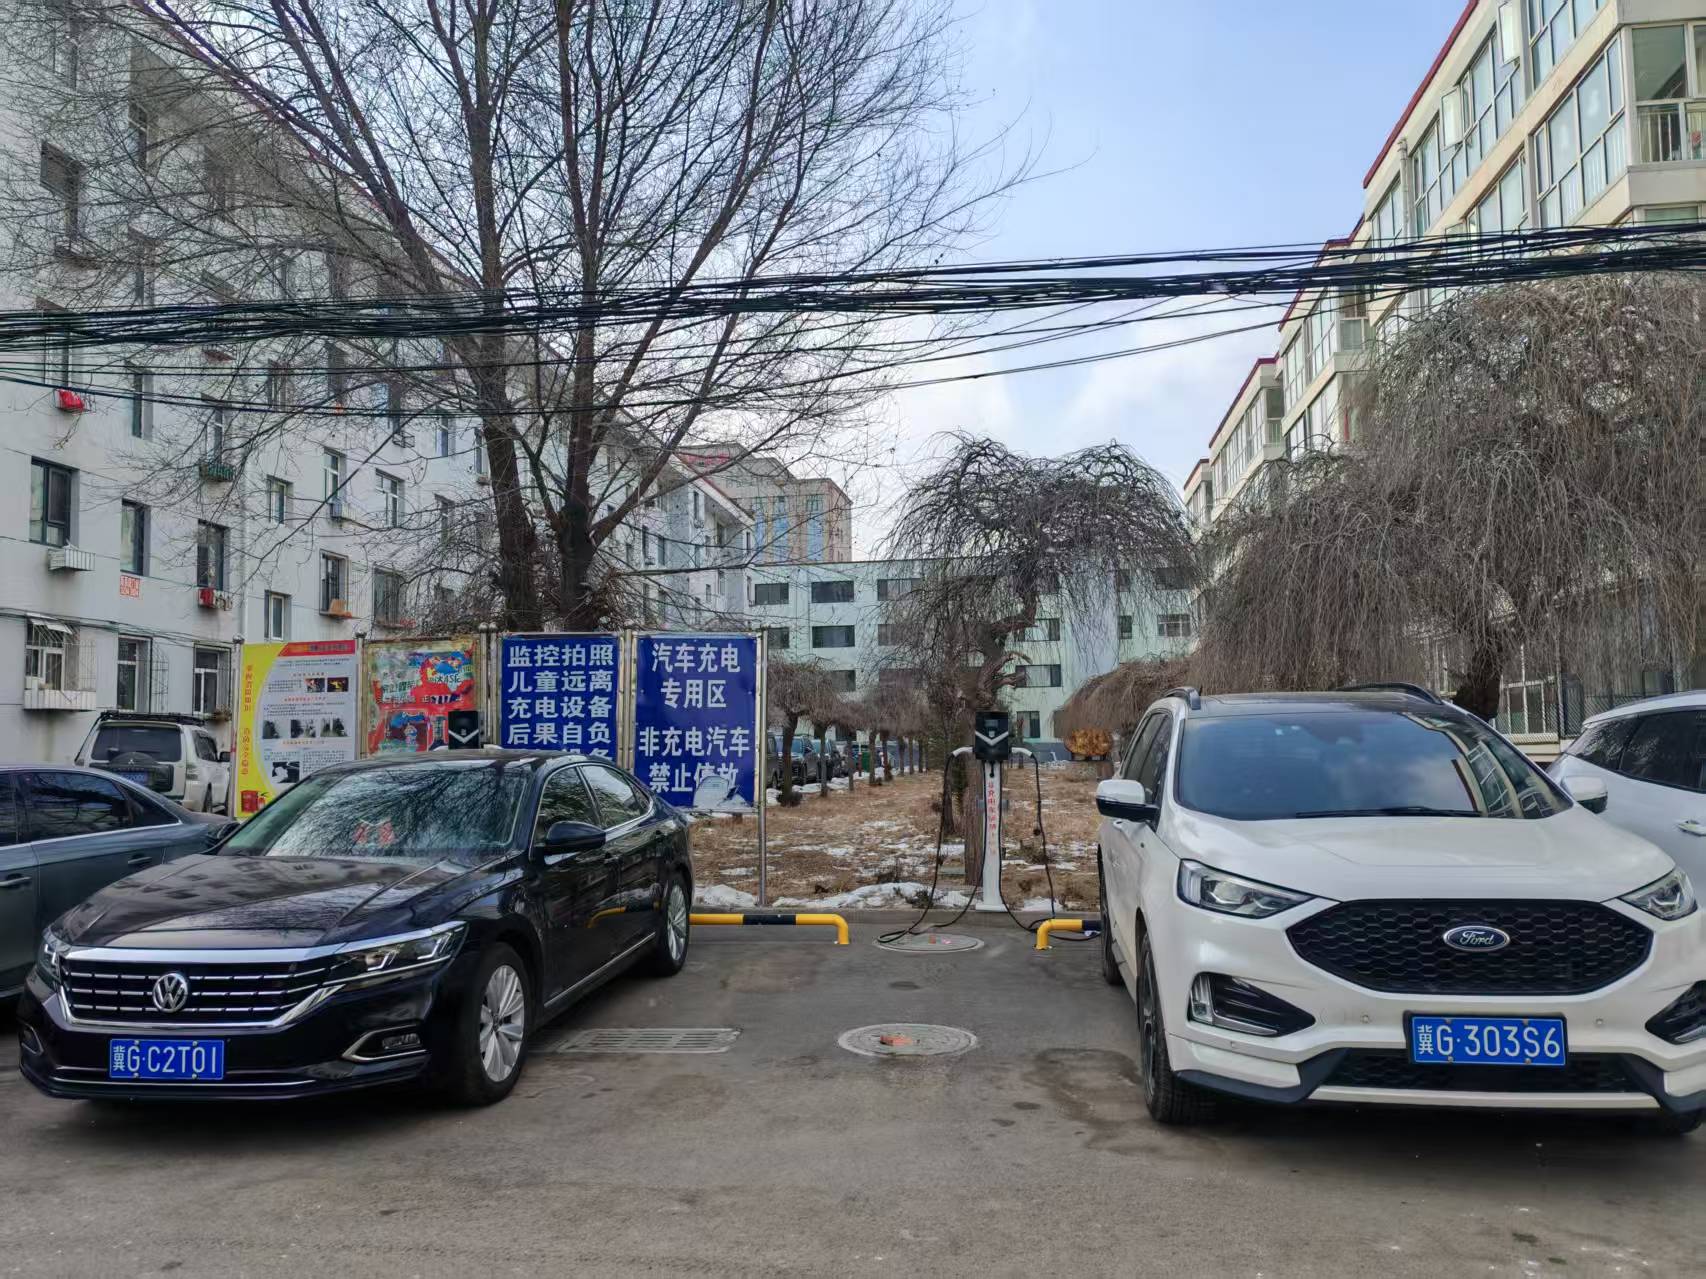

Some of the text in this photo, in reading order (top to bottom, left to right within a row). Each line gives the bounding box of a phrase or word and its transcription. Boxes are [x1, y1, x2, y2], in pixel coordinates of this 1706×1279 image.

[507, 644, 614, 668] 监控拍照
[651, 642, 741, 673] 汽车充电
[507, 669, 613, 693] 儿童远离
[660, 678, 727, 709] 专用区
[507, 695, 612, 719] 充电设备
[507, 721, 611, 745] 后果自负
[638, 726, 750, 758] 非充电汽车
[1459, 930, 1494, 947] Ford
